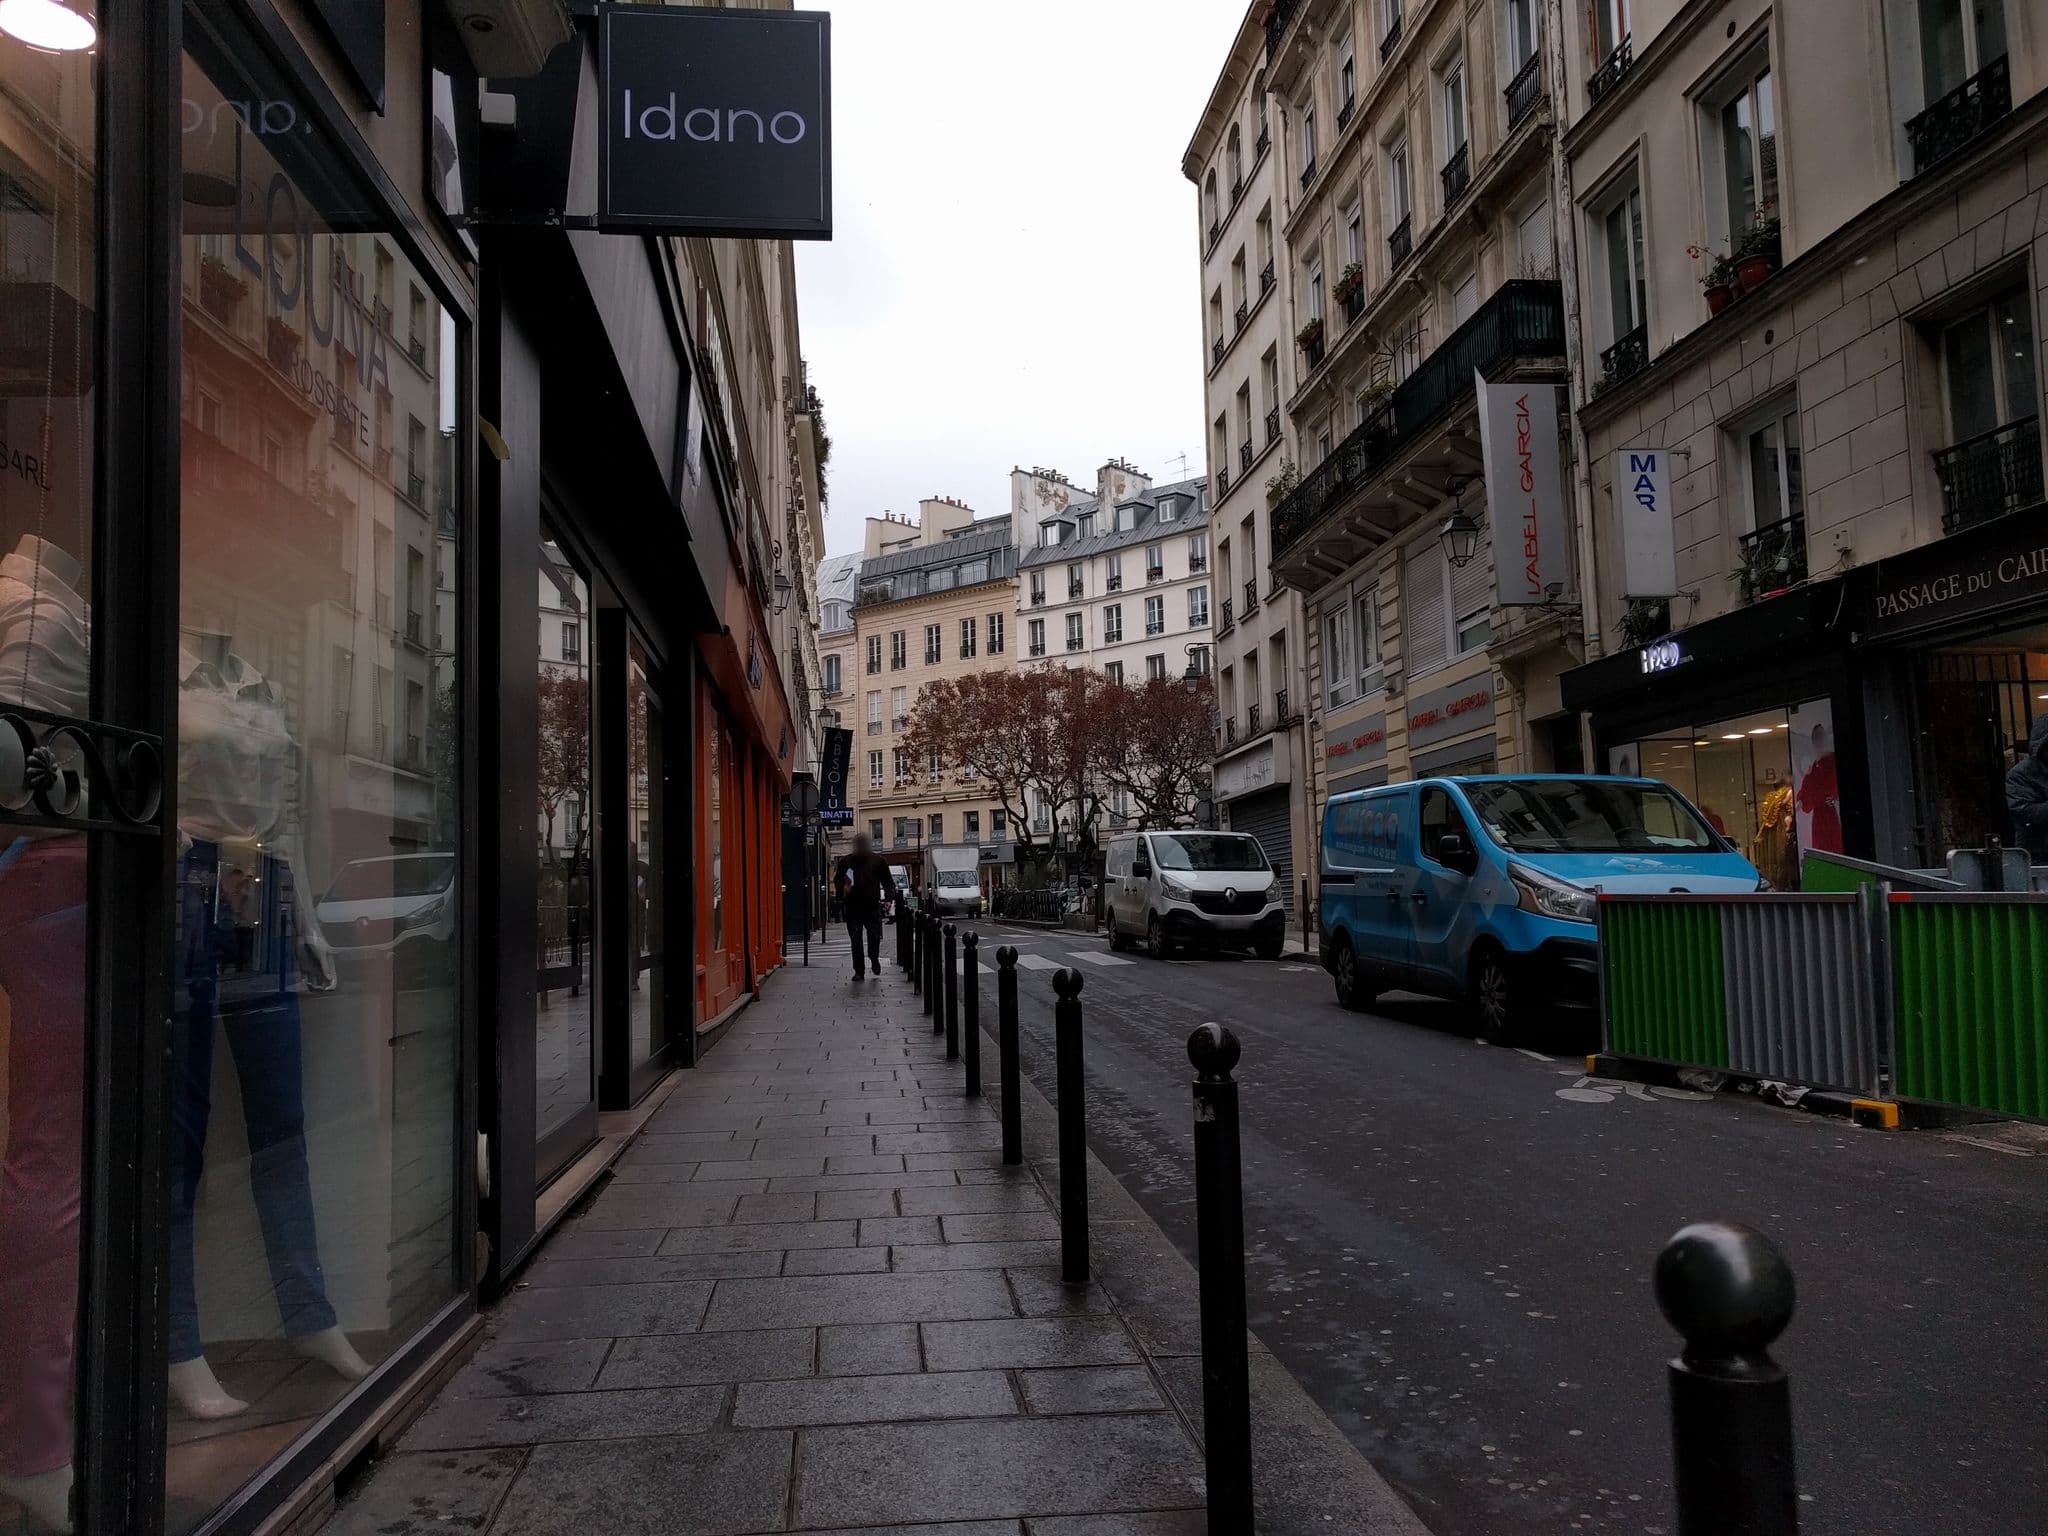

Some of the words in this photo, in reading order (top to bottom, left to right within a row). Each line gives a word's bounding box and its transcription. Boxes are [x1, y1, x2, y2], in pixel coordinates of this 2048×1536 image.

[624, 88, 806, 144] Idano
[280, 345, 369, 447] ROSSISTE
[1515, 392, 1534, 493] GARCIA
[1629, 454, 1657, 512] MAR
[1875, 573, 1962, 619] PASSAGE
[1967, 570, 1993, 594] DU
